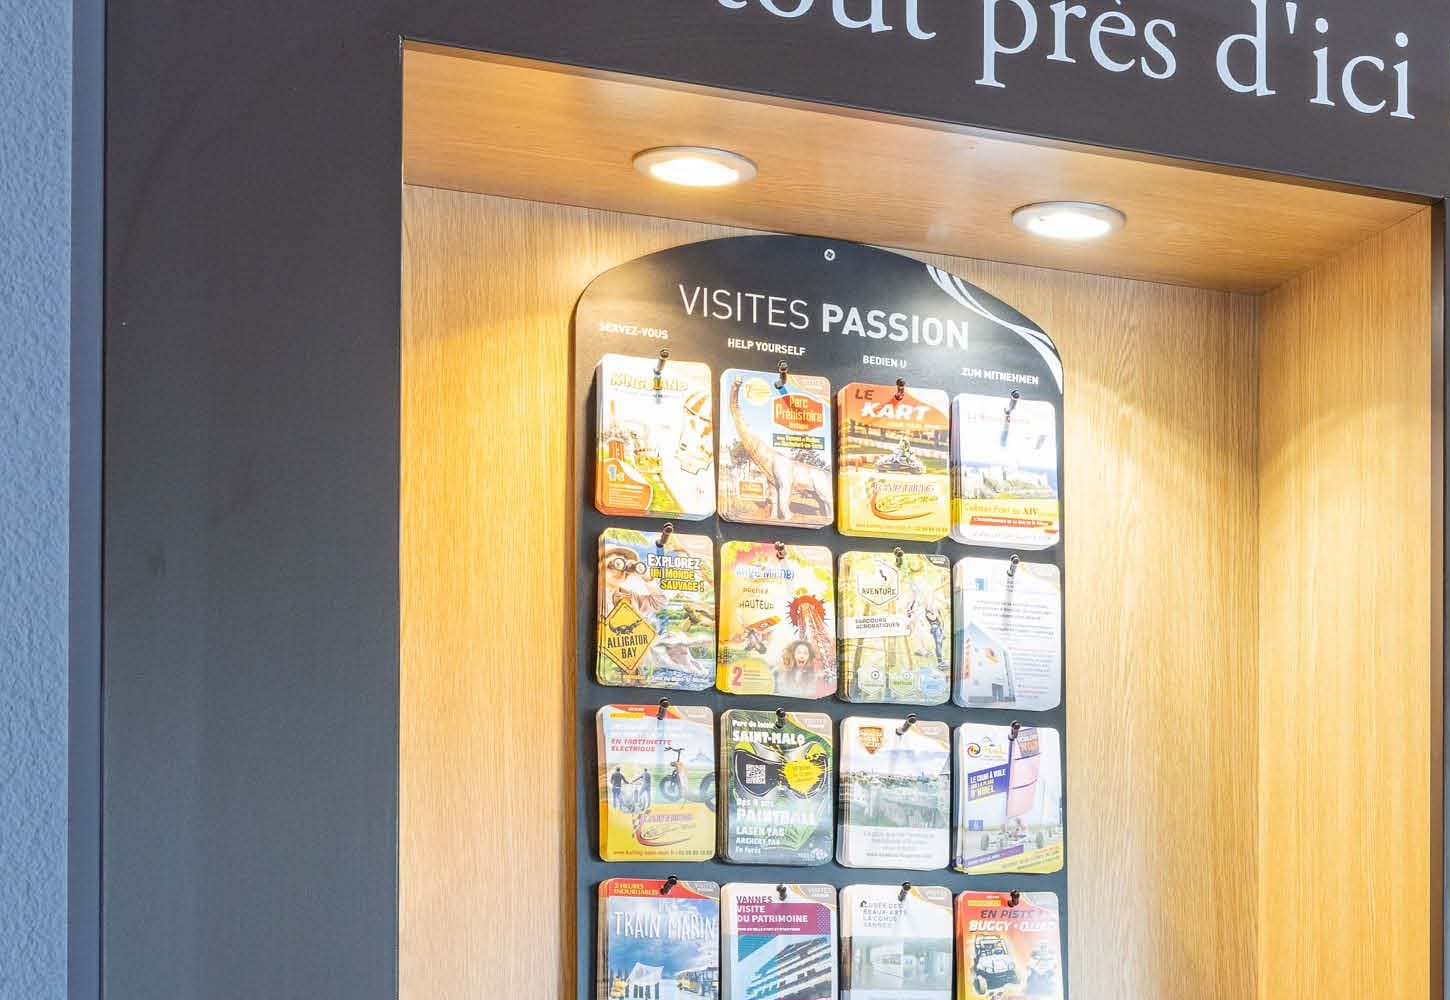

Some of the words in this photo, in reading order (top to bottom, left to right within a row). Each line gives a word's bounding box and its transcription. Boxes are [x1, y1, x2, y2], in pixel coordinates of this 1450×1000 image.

[975, 0, 1177, 88] près
[1216, 0, 1415, 119] d'ici
[678, 283, 809, 330] VISITES
[822, 303, 969, 350] PASSION
[599, 322, 669, 340] SERVEZ-VOUS
[727, 337, 754, 350] HELP
[755, 342, 807, 356] YOURSELF
[863, 354, 898, 368] BEDIEN
[960, 367, 982, 379] ZUM
[983, 370, 1040, 386] MITNEHMEN
[855, 388, 875, 400] LE
[860, 401, 931, 421] KART
[647, 553, 701, 570] EXPLOREZ
[650, 568, 662, 579] UN
[665, 569, 694, 580] MONDE
[660, 578, 698, 592] SAUVAGE
[861, 586, 897, 596] AVENTURE
[607, 633, 649, 648] ALLIGATOR
[621, 646, 638, 660] BAY
[732, 729, 806, 746] SAINT-MALO
[736, 895, 773, 904] VANNES
[736, 905, 766, 913] VISITE
[752, 914, 808, 923] PATRIMOINE
[614, 911, 660, 939] TRAIN
[668, 912, 716, 942] MARIN
[968, 920, 1010, 932] BUGGY
